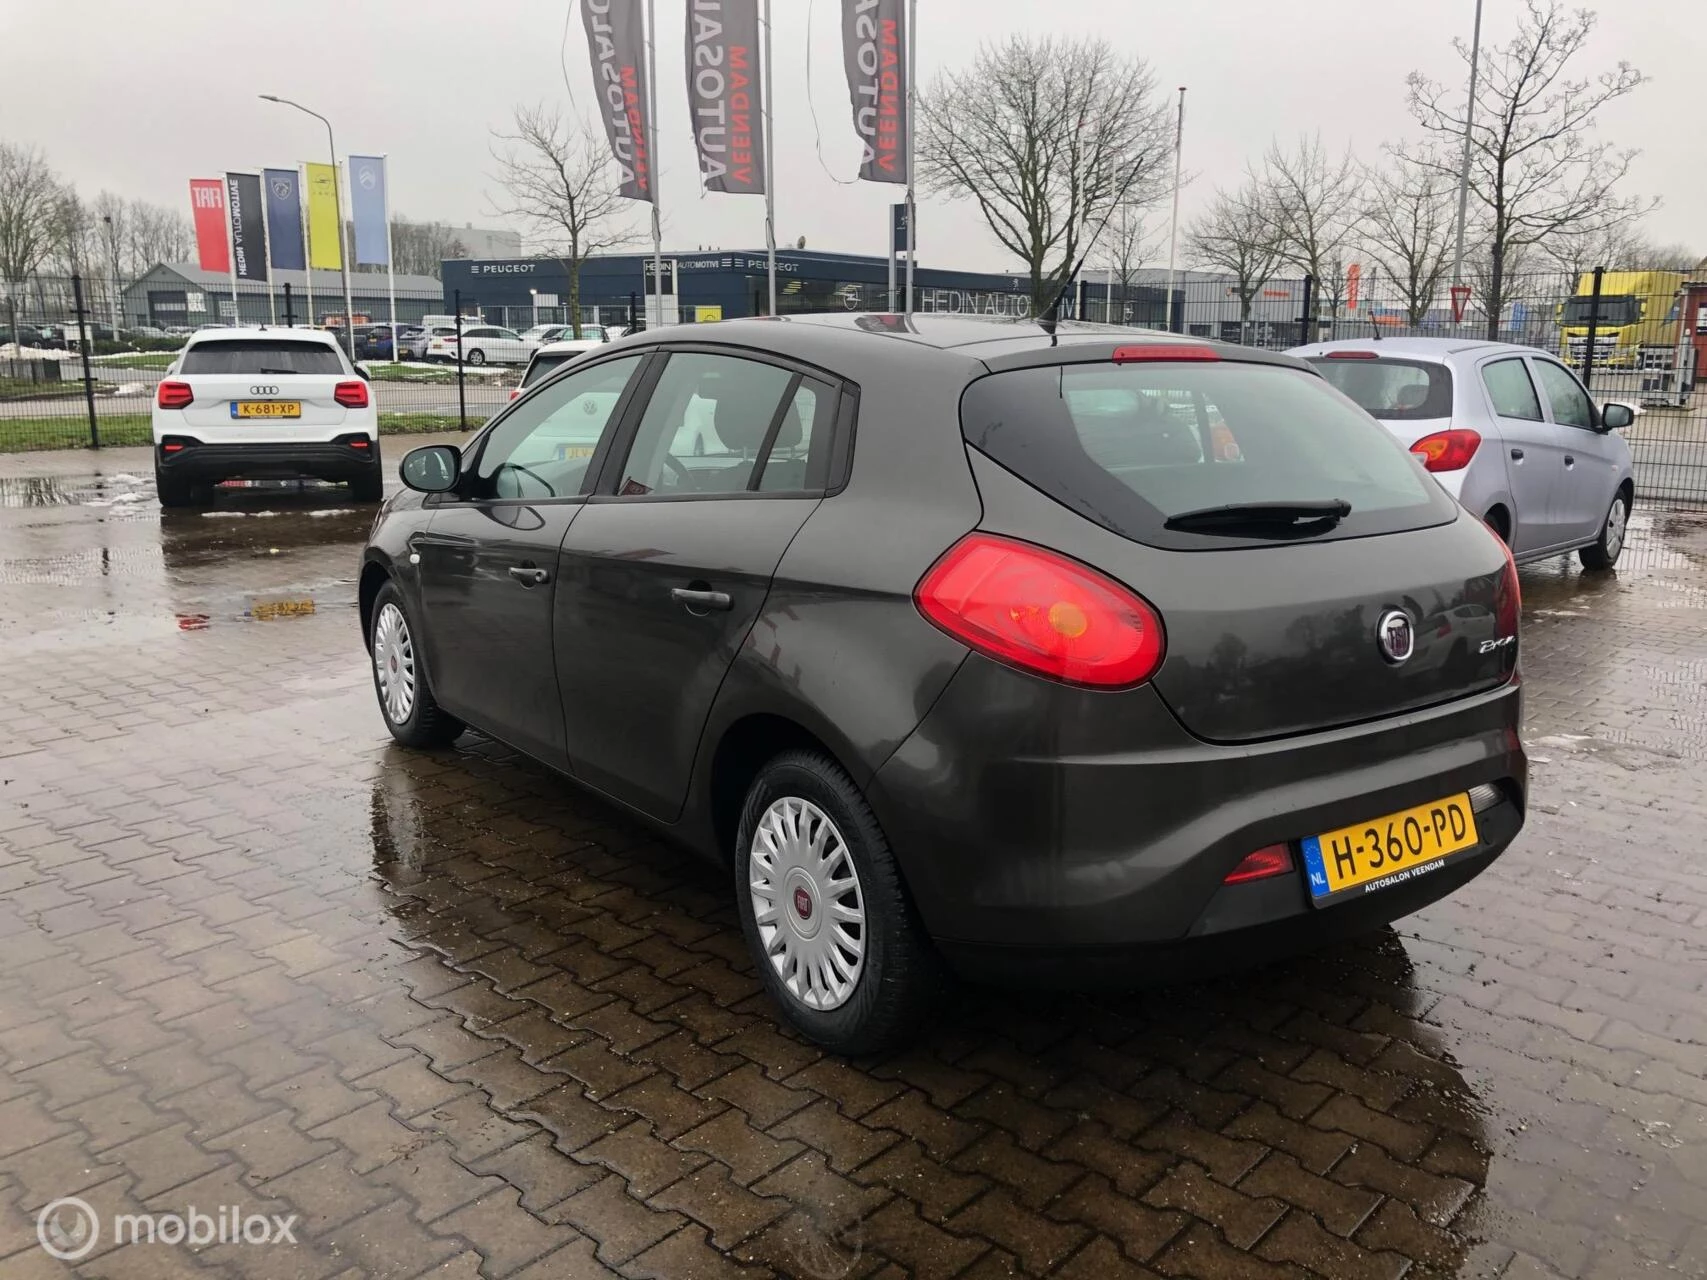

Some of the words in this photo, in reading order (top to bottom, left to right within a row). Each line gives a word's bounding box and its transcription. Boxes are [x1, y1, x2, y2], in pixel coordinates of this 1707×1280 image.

[483, 264, 536, 274] PEUGEOT
[921, 288, 978, 314] HEDIN
[243, 403, 295, 414] K-681-XP
[1331, 804, 1466, 880] H-360-PD
[1311, 873, 1325, 886] NL
[1365, 871, 1410, 893] AUTOSALON
[1411, 858, 1445, 878] VEENDAM
